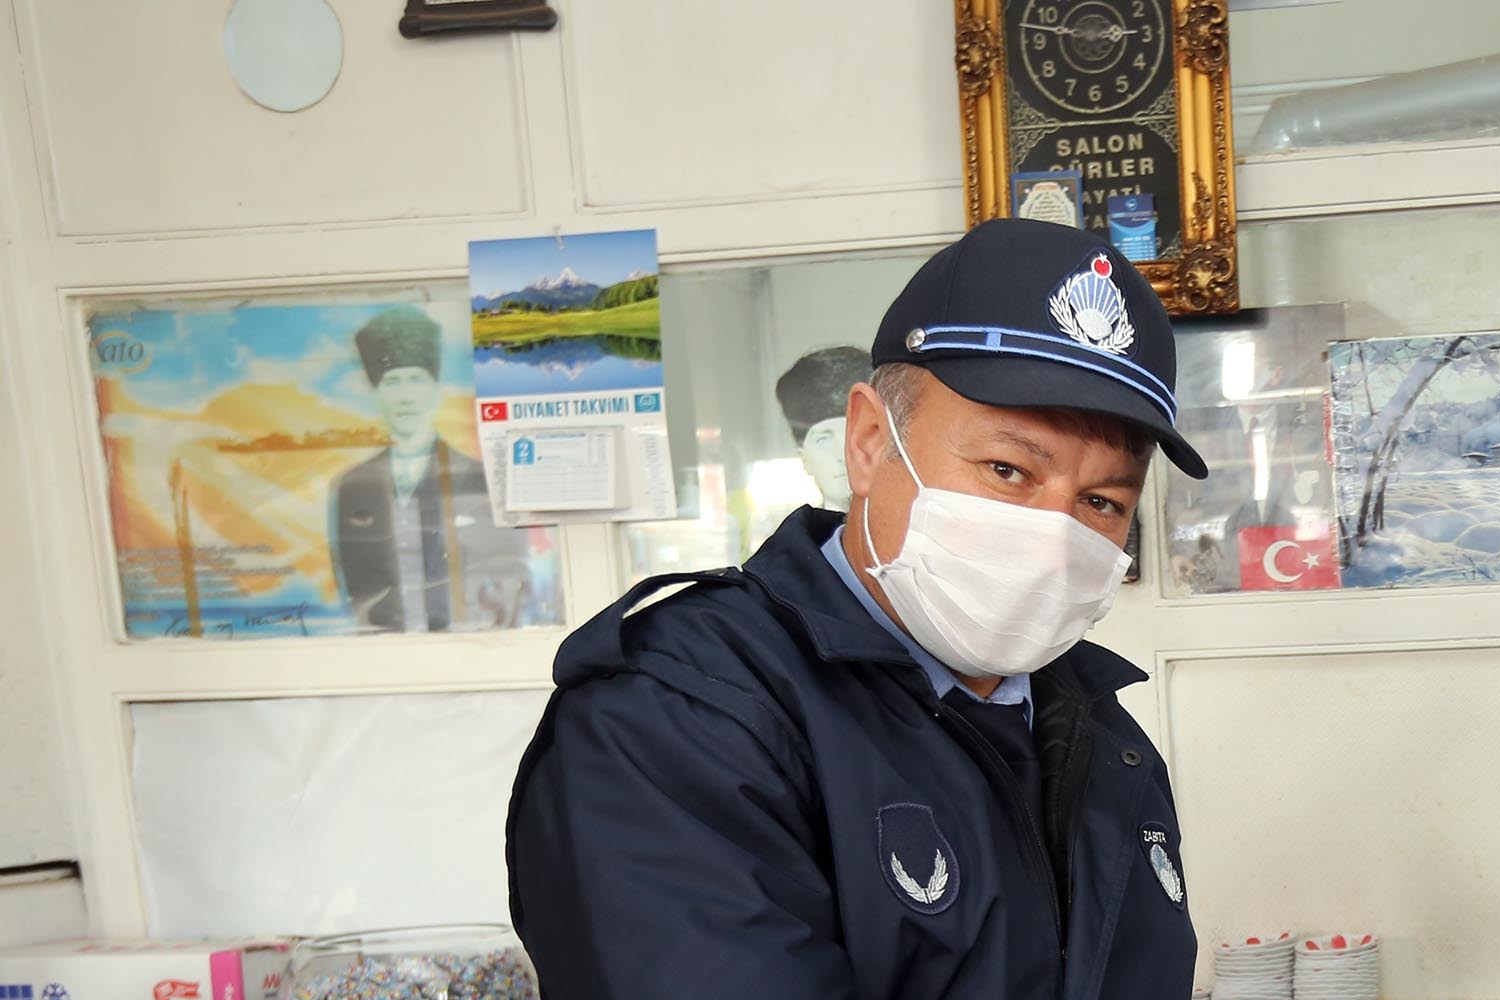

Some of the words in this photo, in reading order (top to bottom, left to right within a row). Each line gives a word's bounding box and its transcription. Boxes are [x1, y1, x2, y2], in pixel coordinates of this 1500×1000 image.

[1037, 7, 1058, 24] 10
[1033, 33, 1047, 50] 9
[1141, 26, 1153, 43] 3
[1042, 60, 1056, 78] 8
[1132, 53, 1147, 70] 4
[1064, 79, 1077, 96] 7
[1116, 75, 1130, 93] 5
[1088, 85, 1102, 102] 6
[1056, 132, 1144, 157] SALON
[519, 443, 530, 458] 2
